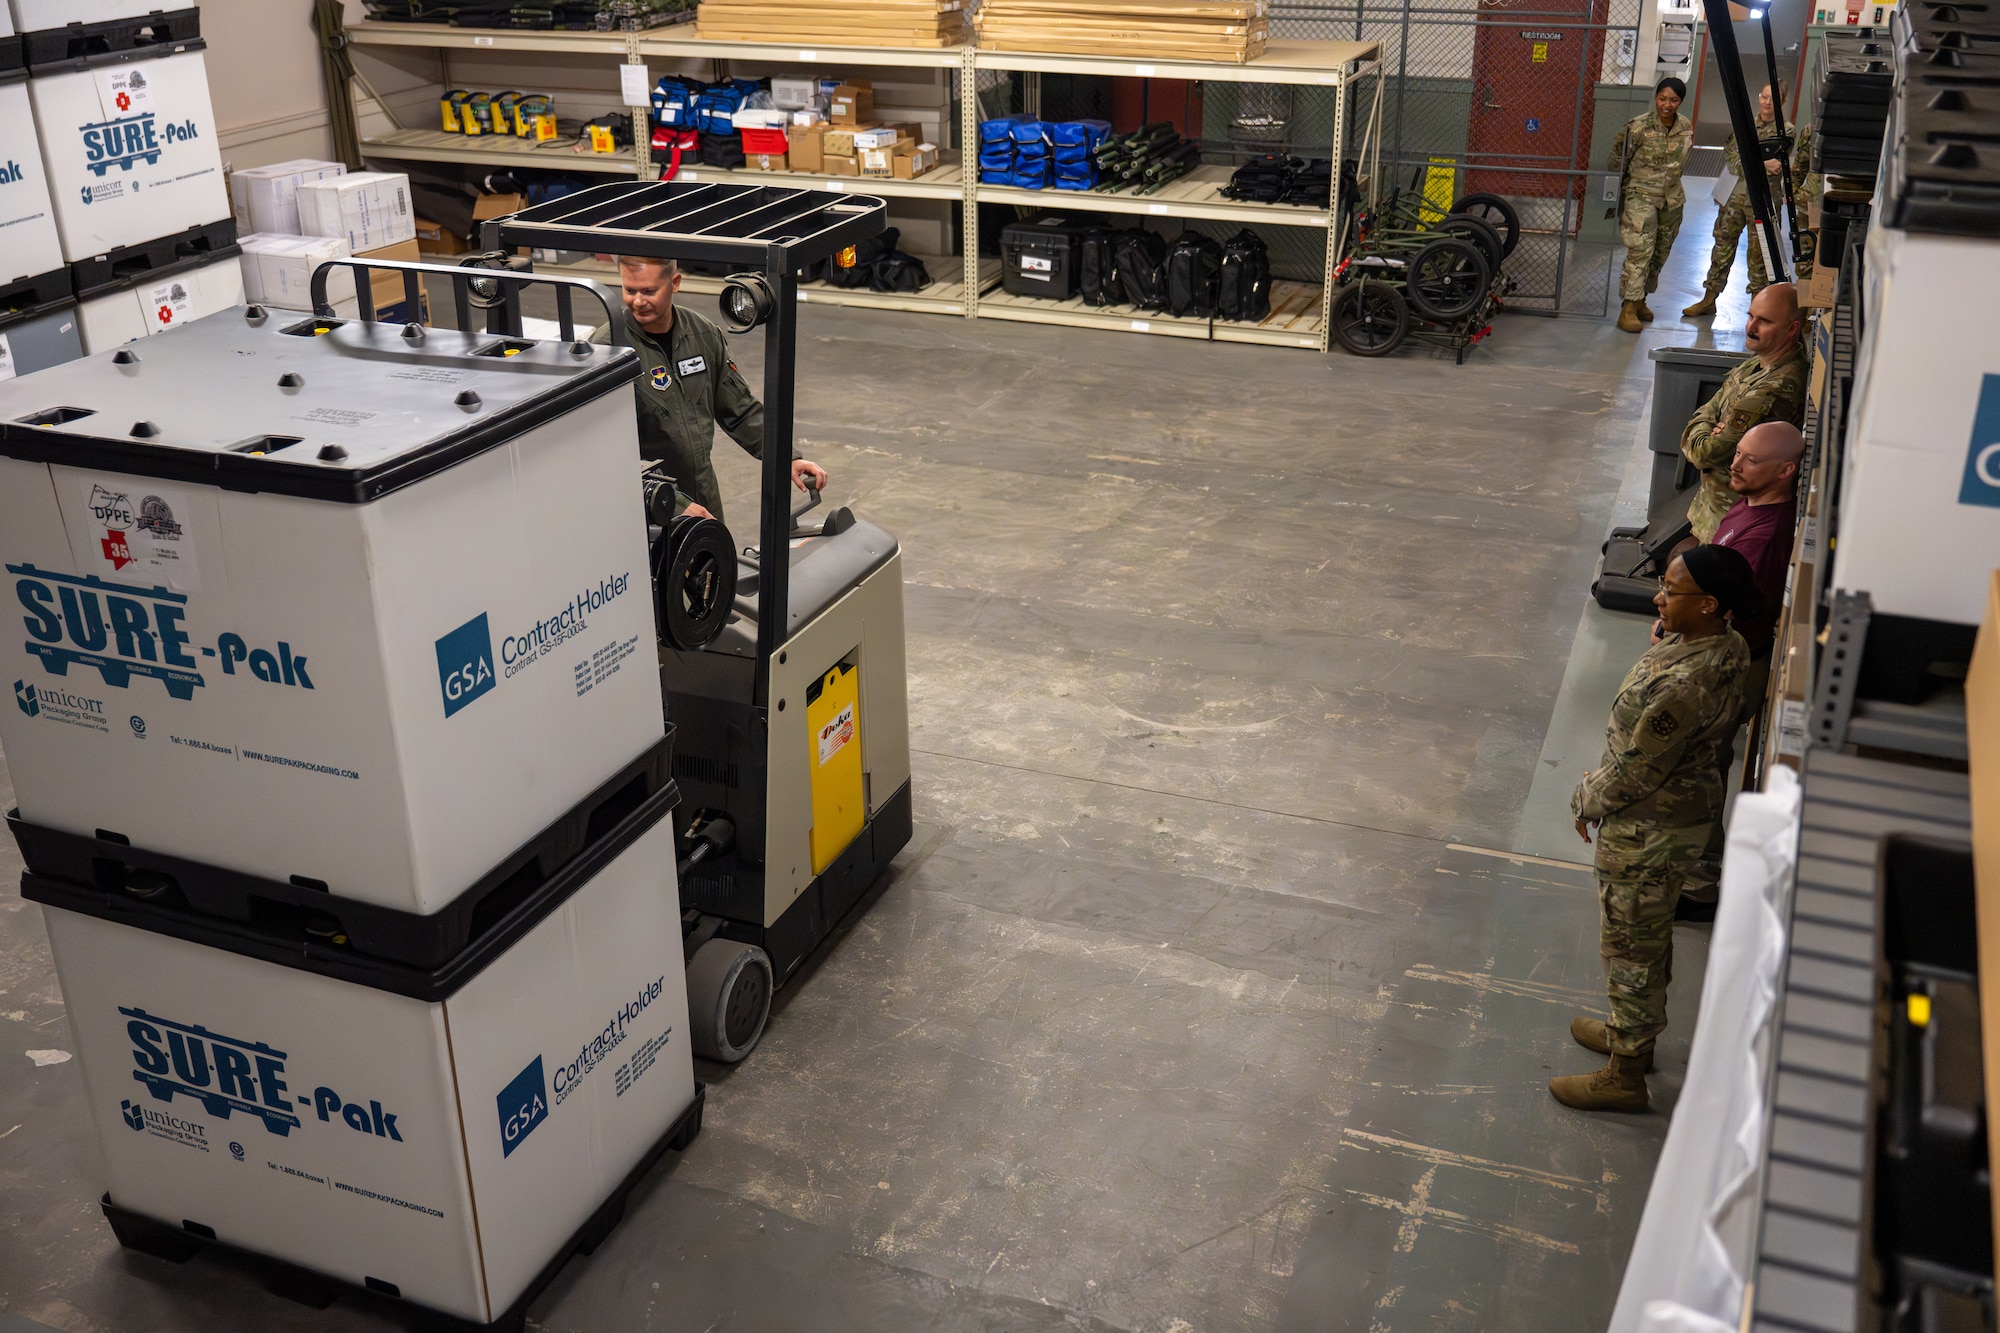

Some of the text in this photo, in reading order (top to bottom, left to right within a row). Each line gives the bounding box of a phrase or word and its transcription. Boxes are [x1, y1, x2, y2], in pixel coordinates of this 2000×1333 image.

[1522, 32, 1561, 40] RESTROOM
[92, 181, 122, 194] unicorr
[95, 506, 131, 524] DPPE
[110, 542, 129, 559] 35
[502, 572, 629, 666] Contract Holder
[445, 655, 492, 701] GSA
[504, 650, 538, 679] Contract
[38, 688, 103, 713] unicorr
[41, 704, 107, 724] Packaging Group
[169, 735, 183, 744] Tel:
[821, 711, 851, 740] Deka
[243, 749, 360, 780] WWW.SUREPAKPACKAGING.COM
[553, 1019, 617, 1094] Contract
[617, 976, 664, 1031] Holder
[144, 1108, 205, 1137] unicorr
[504, 1093, 544, 1142] GSA
[146, 1121, 209, 1146] Packaging Group
[334, 1181, 444, 1218] WWW.SUREPAKPACKAGING.COM
